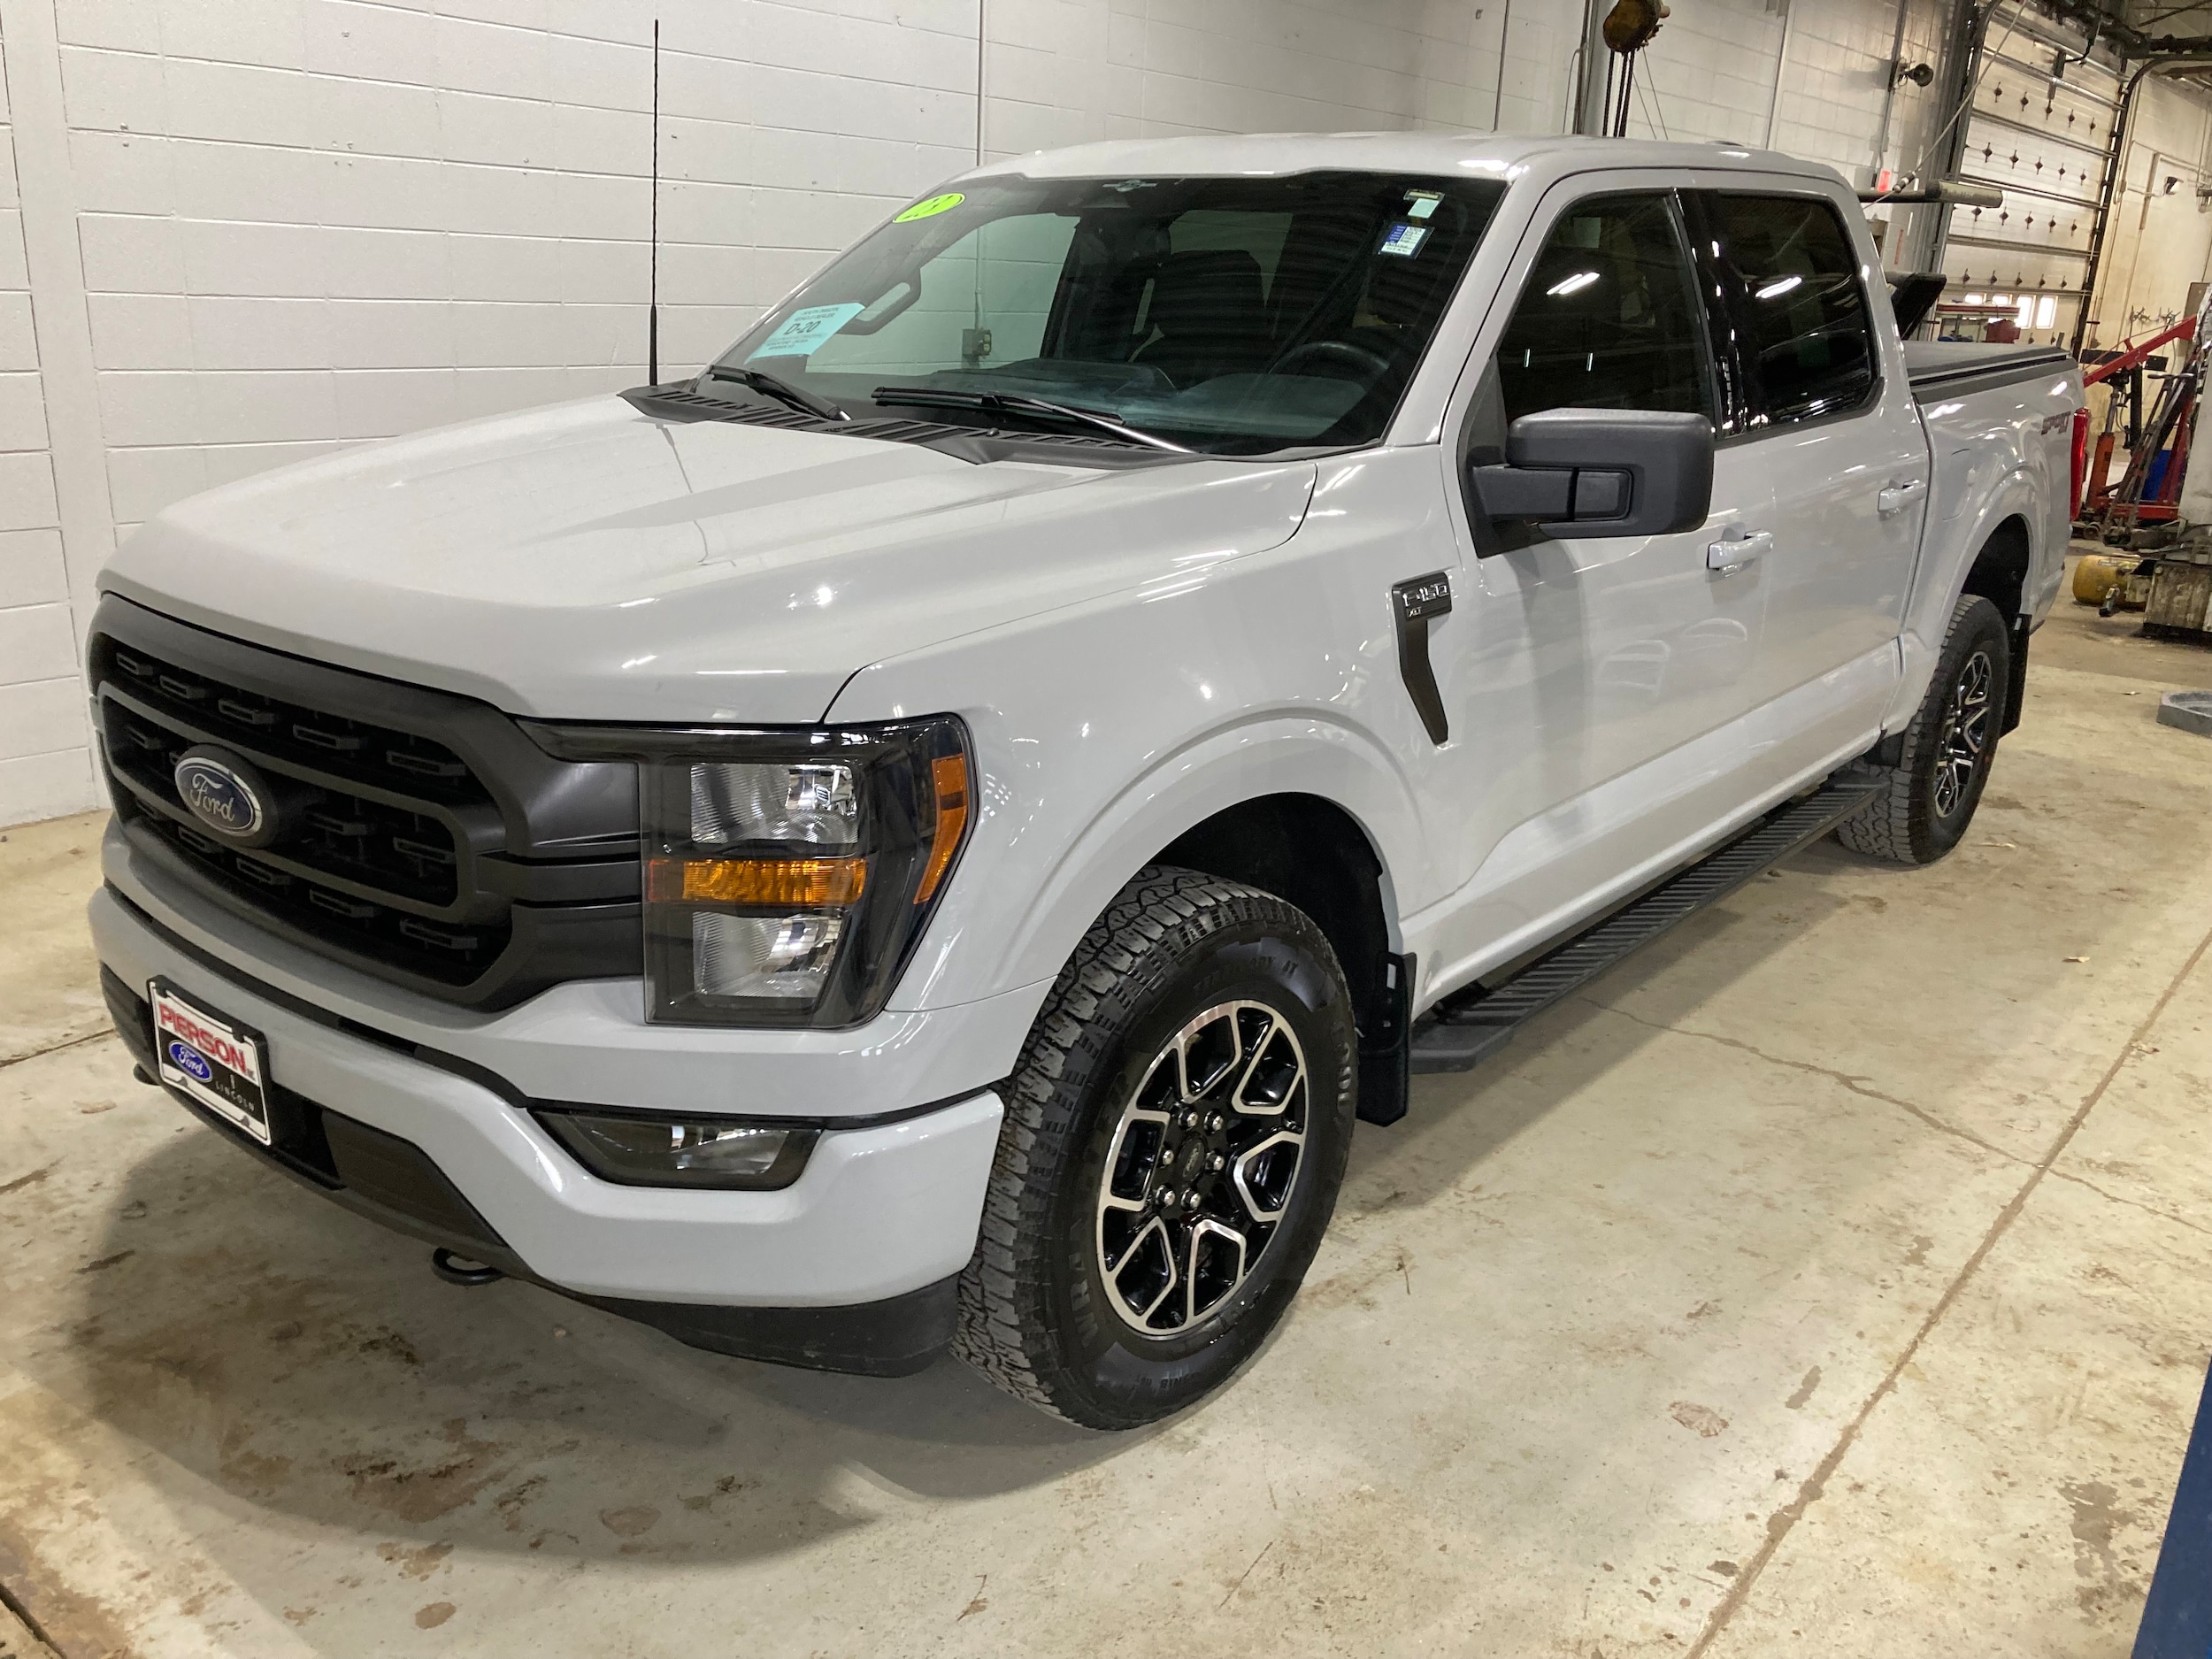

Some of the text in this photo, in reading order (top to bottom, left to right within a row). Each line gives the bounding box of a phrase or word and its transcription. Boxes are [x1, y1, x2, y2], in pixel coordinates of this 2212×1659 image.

[783, 320, 821, 335] D-20
[1402, 582, 1449, 607] F-150
[189, 772, 234, 821] Ford
[158, 1002, 247, 1073] PIERSON
[178, 1046, 204, 1076] Ford
[216, 1080, 255, 1112] LINCOLN
